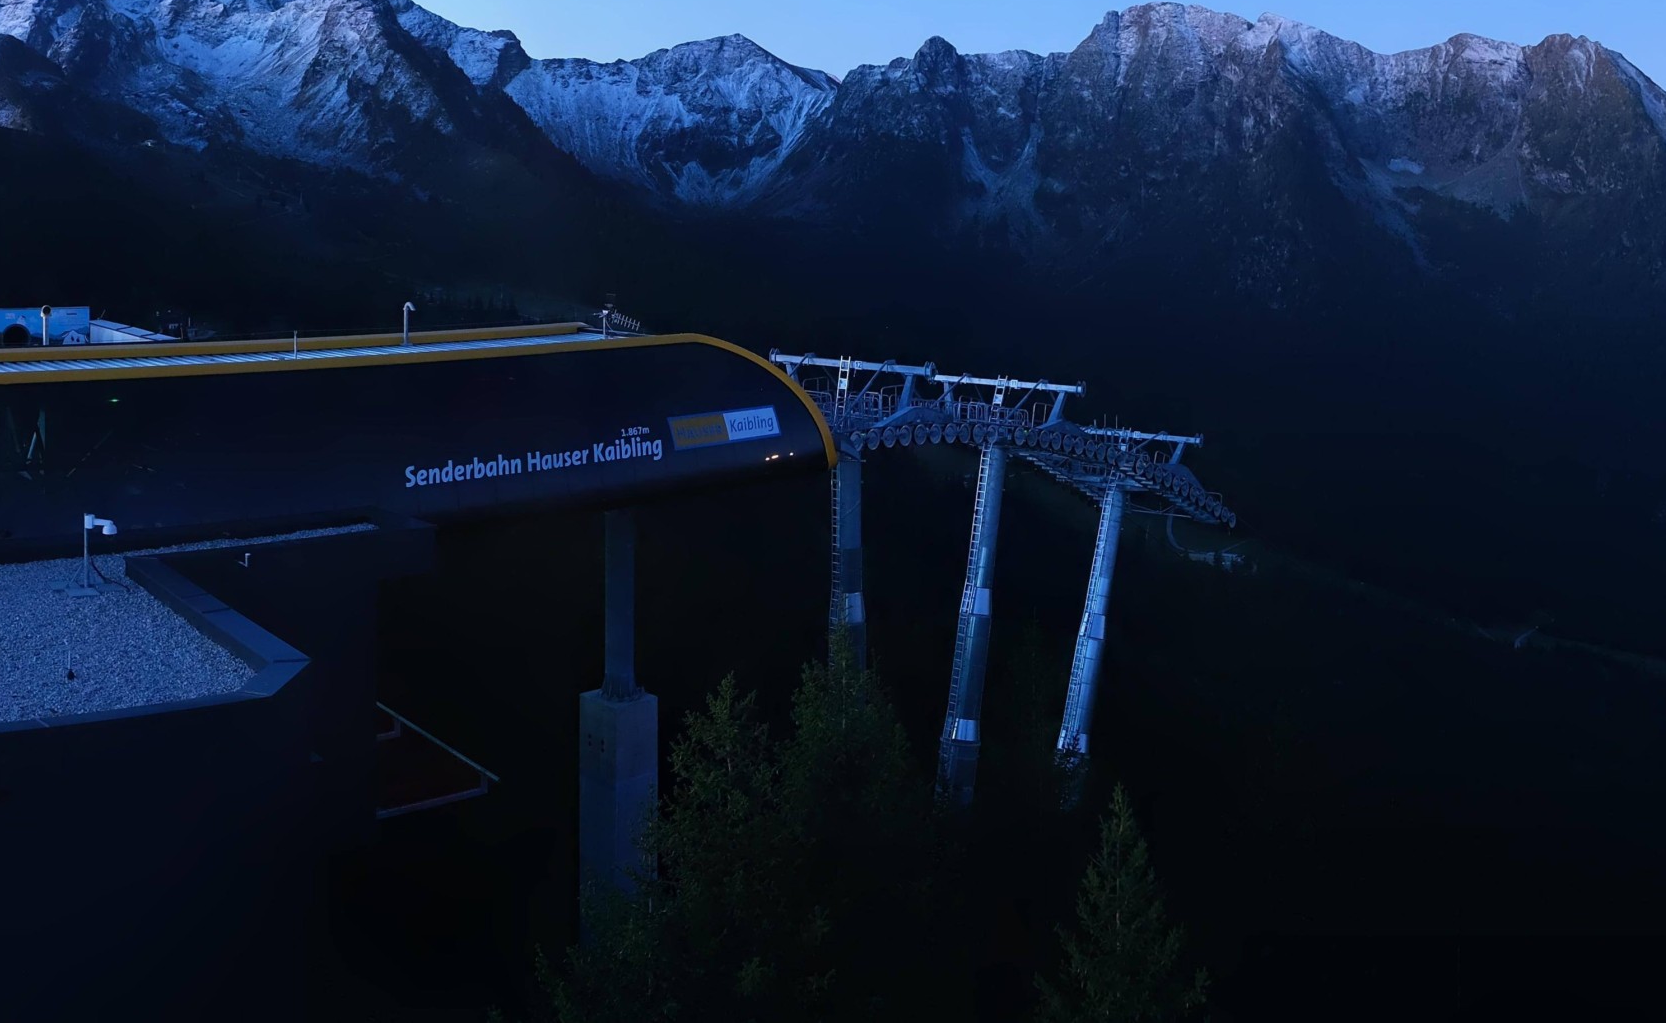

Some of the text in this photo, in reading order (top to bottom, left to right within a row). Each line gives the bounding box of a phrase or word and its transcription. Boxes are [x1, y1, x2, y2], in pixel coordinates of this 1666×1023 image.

[730, 416, 774, 432] Kaibling
[405, 437, 663, 488] Senderbahn Hauser Kaibling
